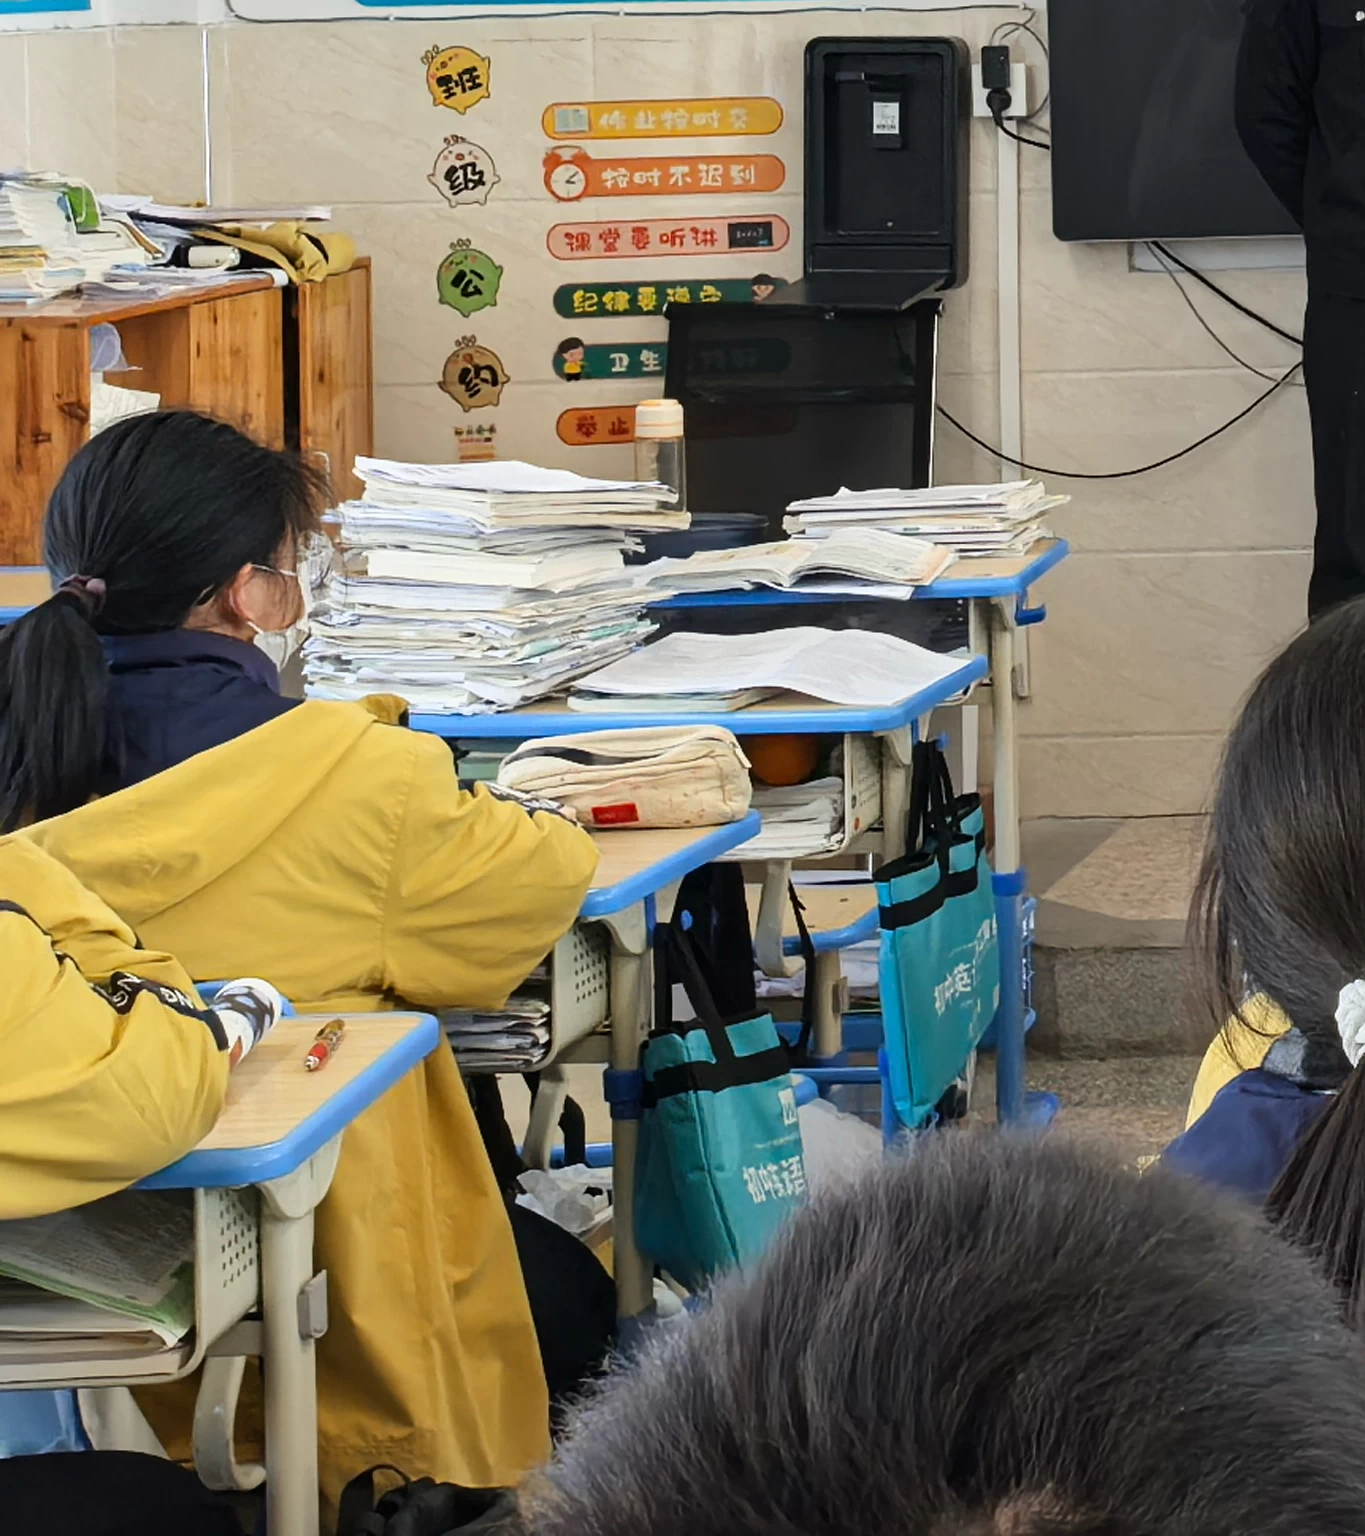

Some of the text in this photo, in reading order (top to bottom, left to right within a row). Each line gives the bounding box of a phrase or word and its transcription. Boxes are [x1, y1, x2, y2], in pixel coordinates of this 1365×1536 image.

[444, 161, 486, 196] 级
[601, 164, 756, 189] 按时不迟到
[563, 225, 718, 253] 课堂要听讲
[451, 267, 485, 299] 公
[609, 349, 662, 373] 卫生
[458, 362, 499, 397] 约
